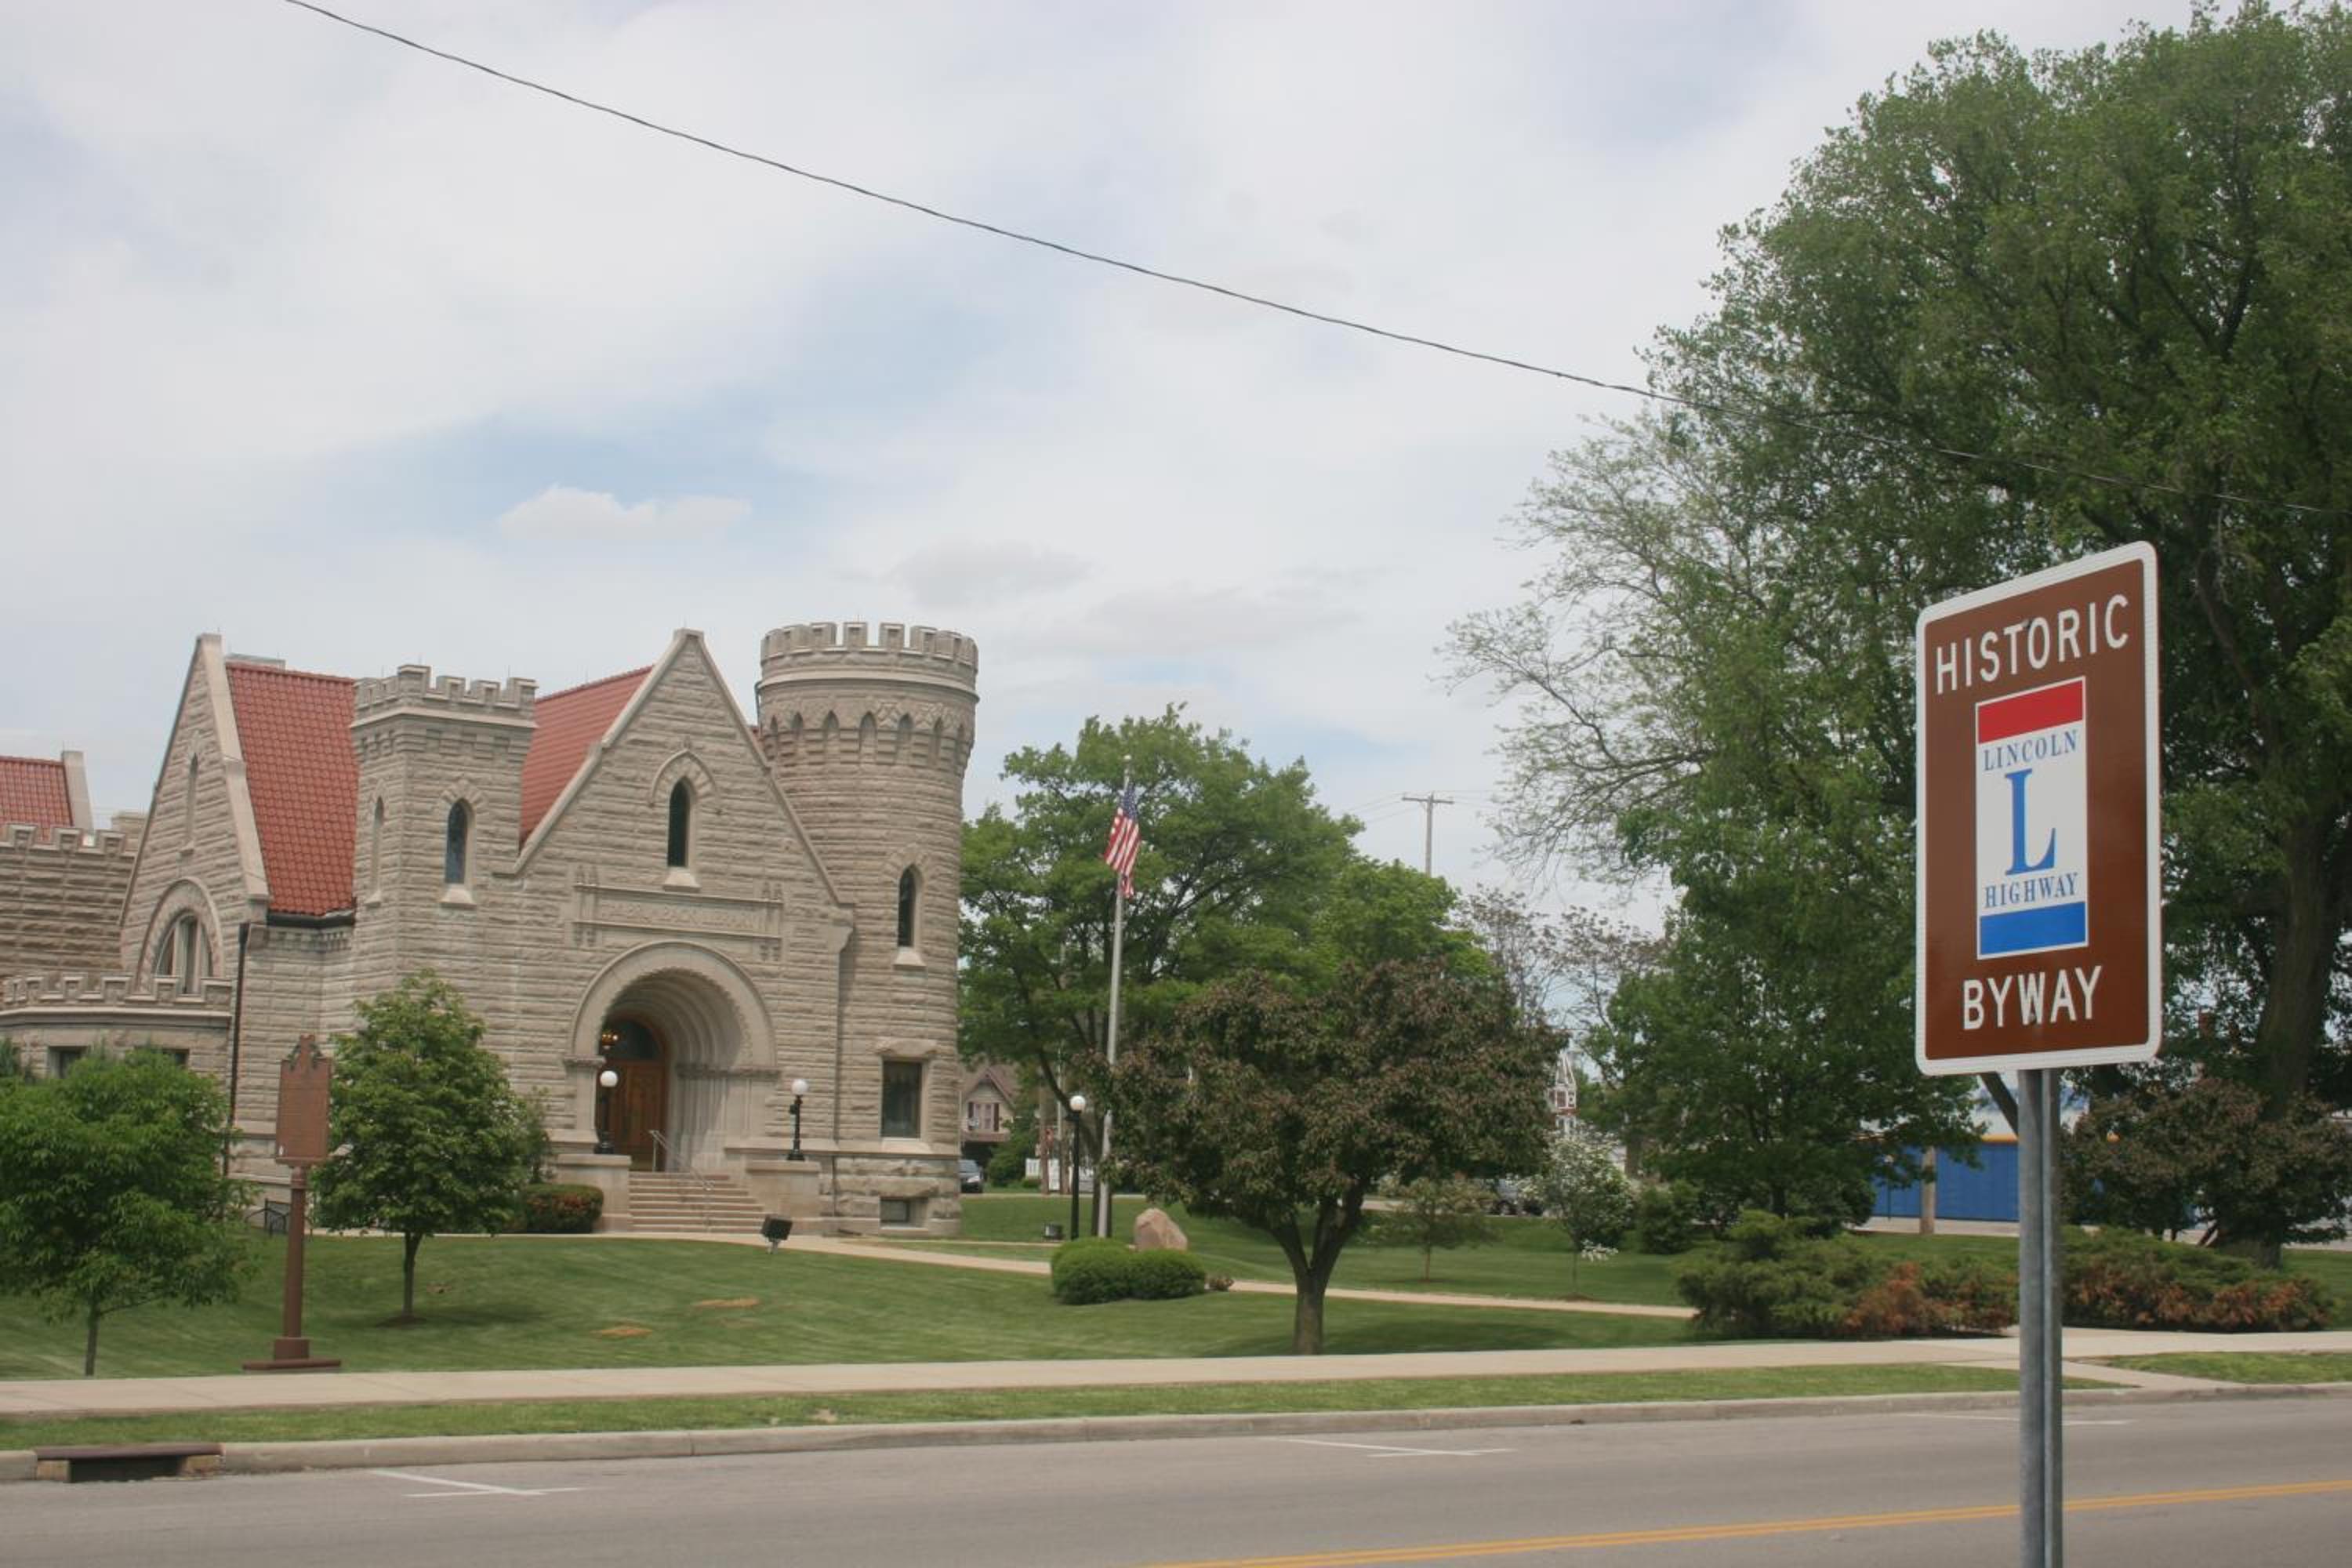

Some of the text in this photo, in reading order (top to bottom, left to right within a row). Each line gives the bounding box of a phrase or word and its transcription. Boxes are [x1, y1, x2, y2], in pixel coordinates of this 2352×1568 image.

[1936, 593, 2129, 695] HISTORIC
[1984, 729, 2078, 771] LINCOLN
[2005, 768, 2056, 876] L
[1984, 872, 2078, 908] HIGHWAY
[1962, 965, 2103, 1030] BYWAY
